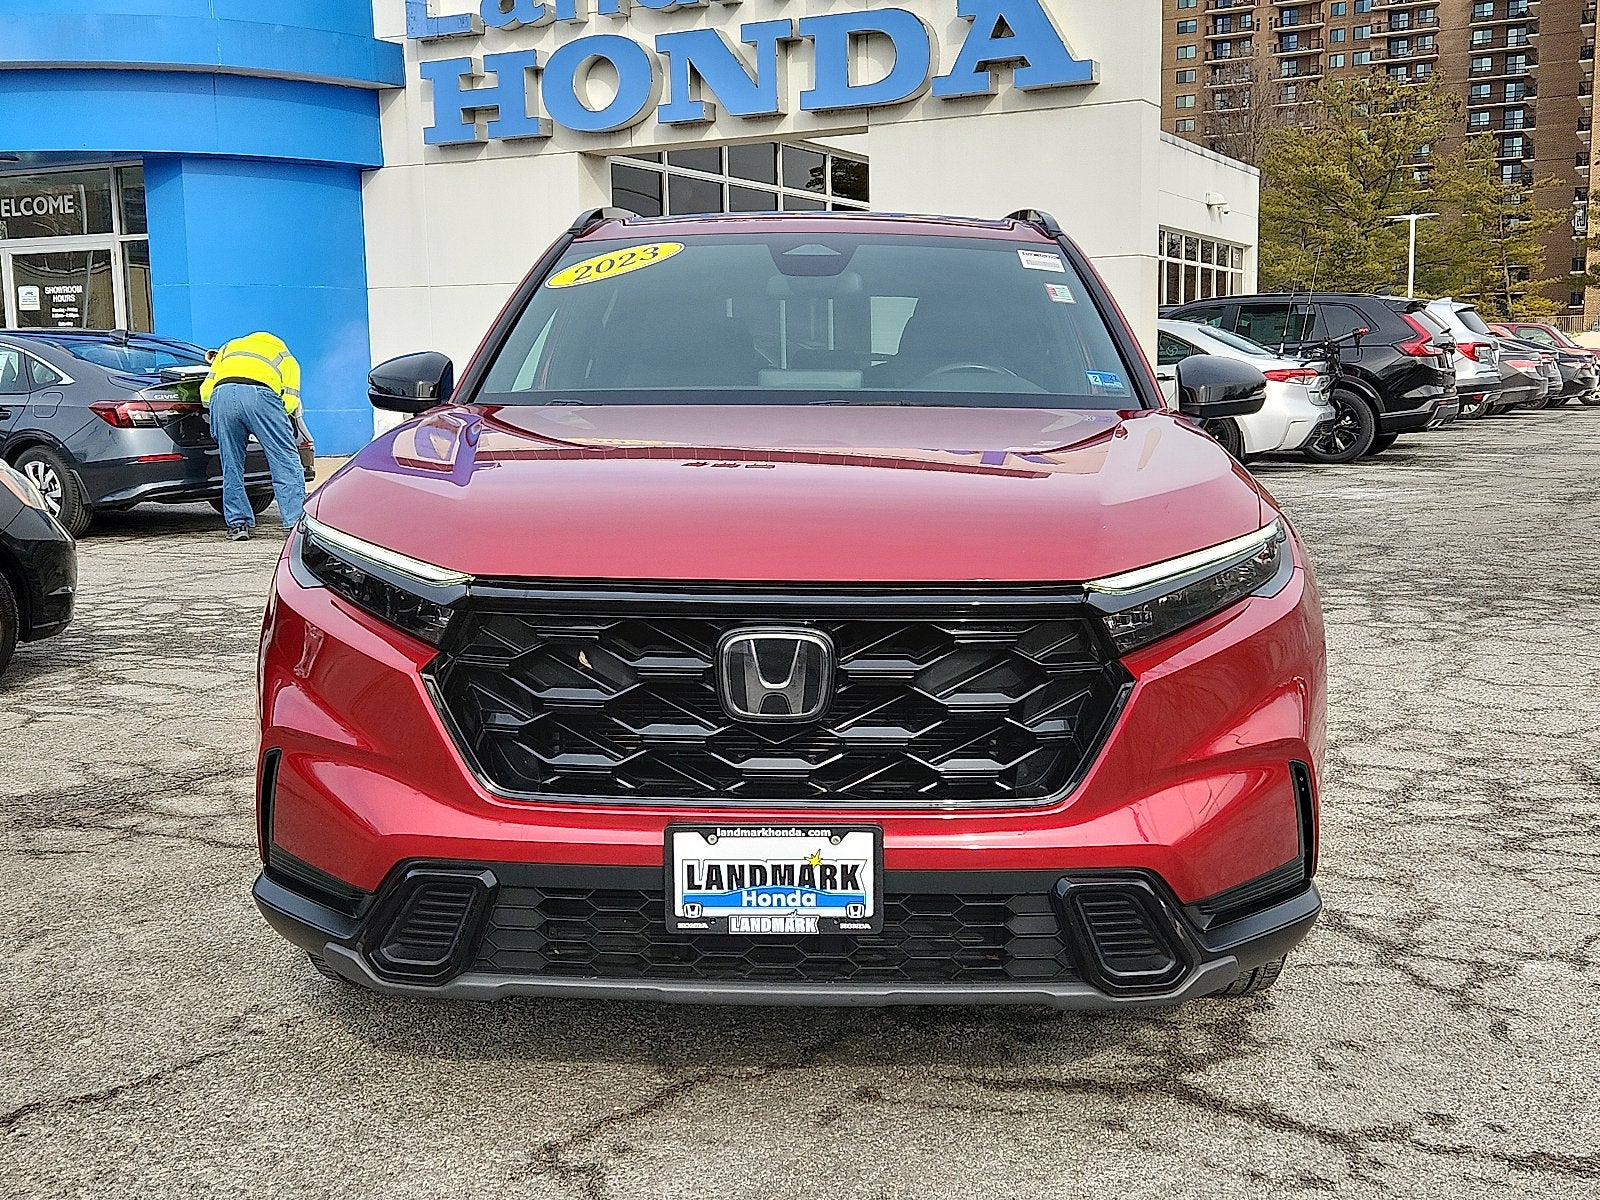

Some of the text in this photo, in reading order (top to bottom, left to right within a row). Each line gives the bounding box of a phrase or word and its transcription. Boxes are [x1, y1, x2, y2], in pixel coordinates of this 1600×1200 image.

[421, 0, 1099, 145] HONDA
[0, 194, 75, 218] ELCOME
[572, 246, 660, 283] 2023
[52, 294, 76, 303] HOURS
[686, 863, 861, 891] LANDMARK
[741, 890, 817, 907] Honda
[730, 918, 817, 932] LANDMARK
